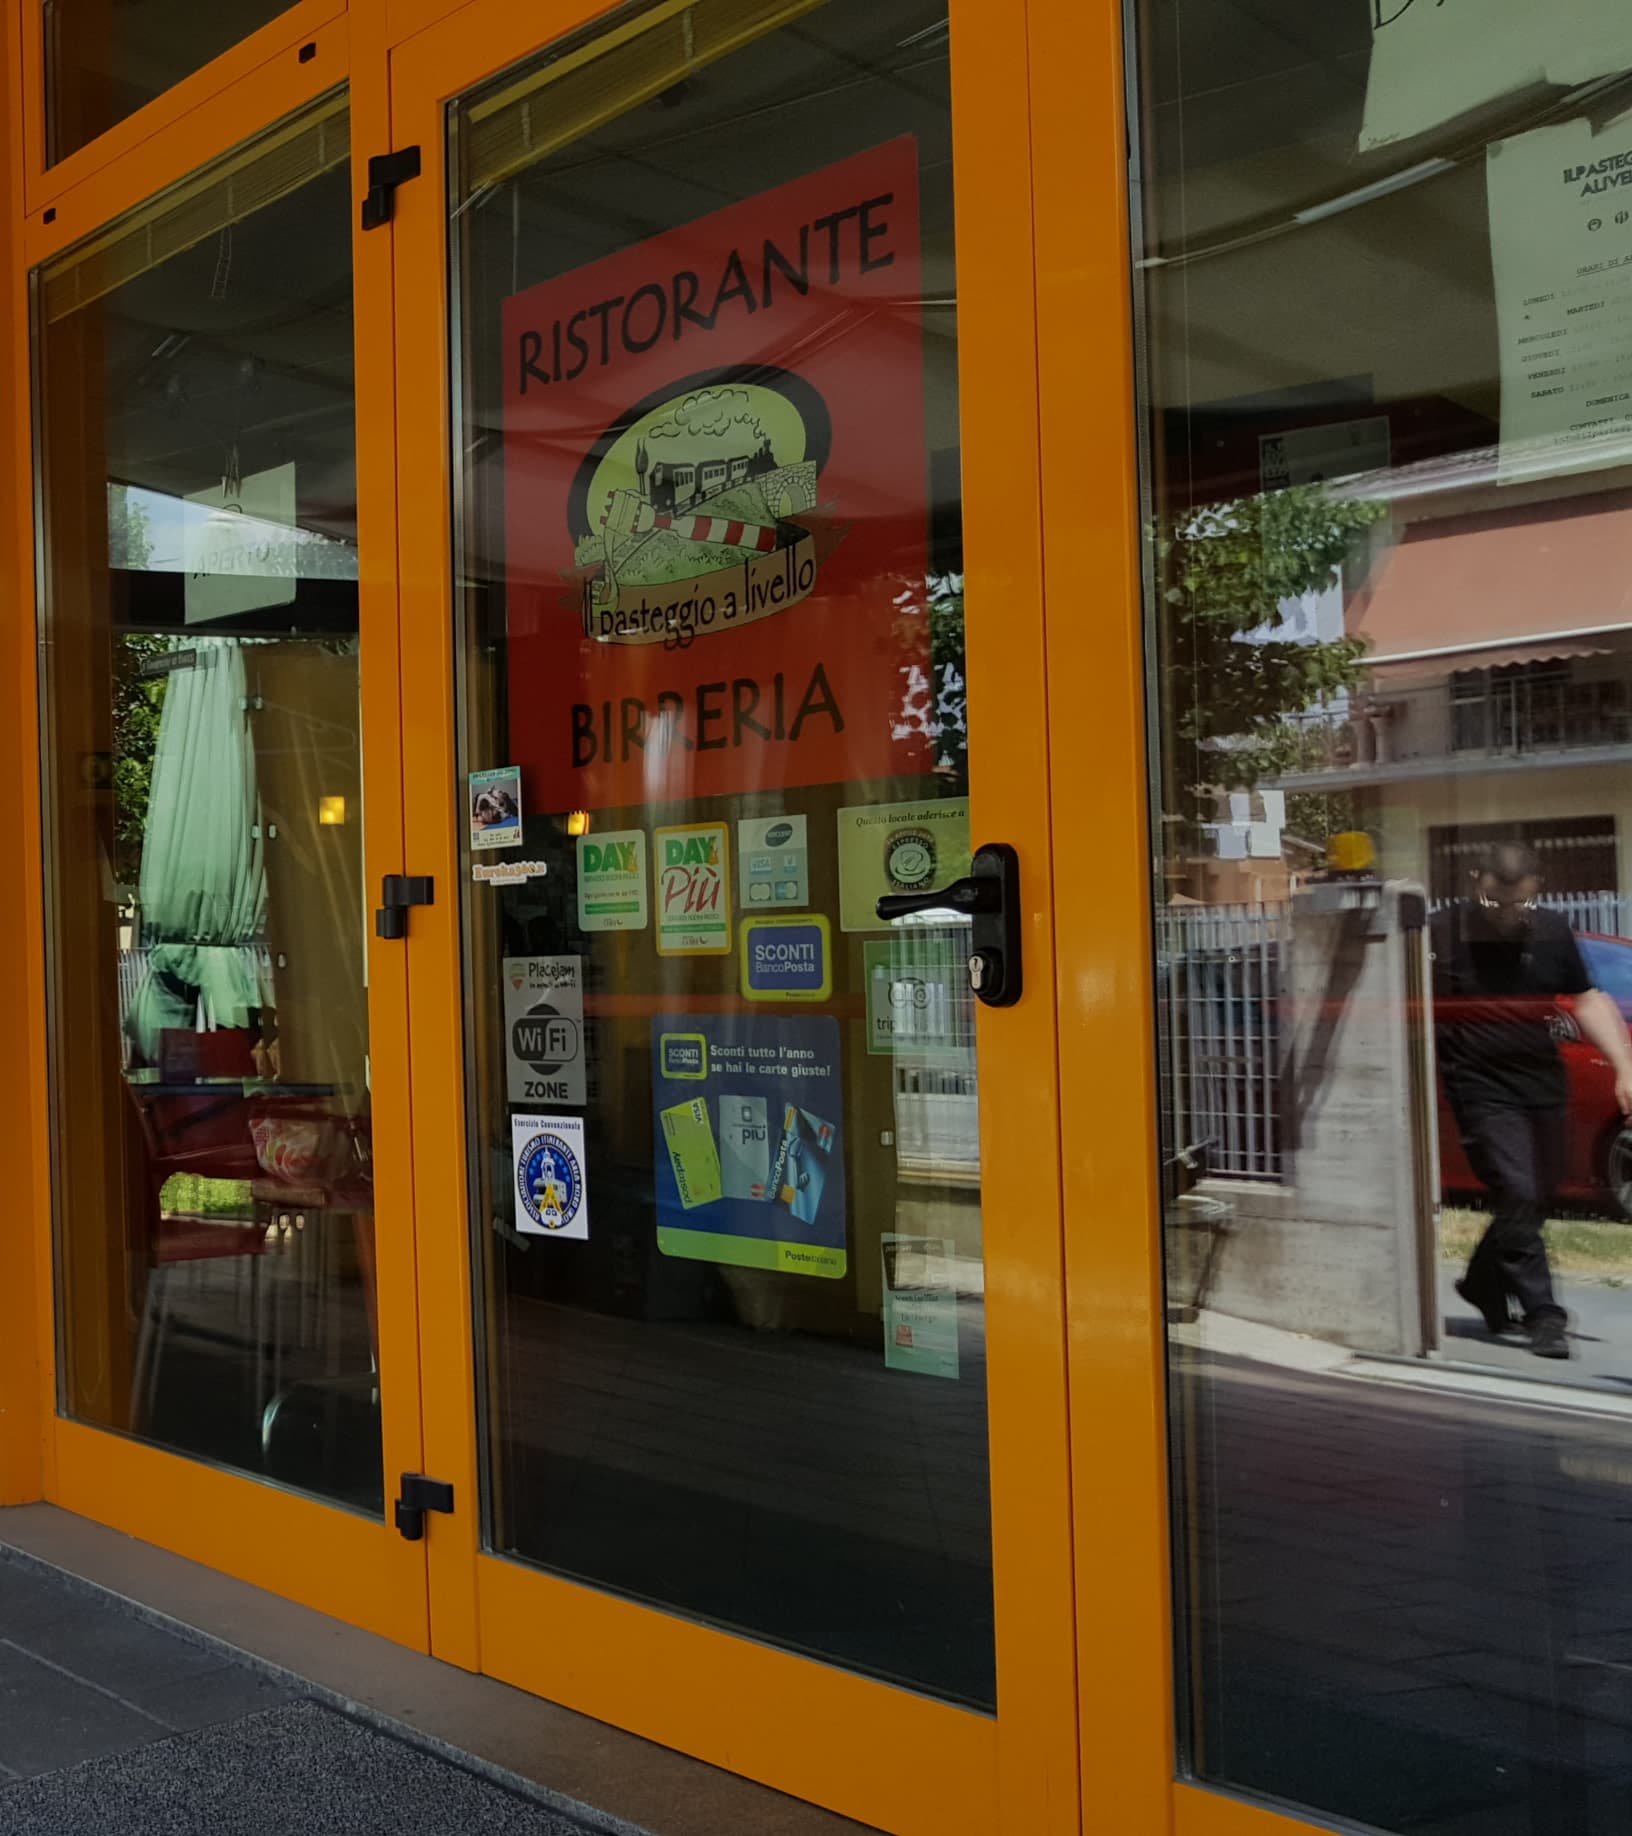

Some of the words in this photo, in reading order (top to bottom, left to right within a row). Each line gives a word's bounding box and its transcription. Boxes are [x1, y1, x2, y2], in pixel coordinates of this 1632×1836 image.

[518, 192, 895, 395] RISTORANTE
[583, 576, 594, 638] Il
[600, 583, 716, 651] pasteggio
[723, 591, 736, 620] a
[745, 542, 814, 615] livello
[571, 662, 845, 769] BIRRERIA
[888, 812, 915, 823] locale
[917, 809, 957, 821] aderisce
[583, 841, 637, 873] DAY
[665, 836, 718, 866] DAY
[661, 866, 721, 913] Più
[892, 877, 929, 889] ITALIANO
[755, 943, 815, 961] SCONTI
[529, 962, 575, 980] Placejam
[755, 961, 816, 974] BancoPosta
[710, 1045, 745, 1056] Sconti
[748, 1047, 776, 1058] tutto
[779, 1047, 815, 1059] l'anno
[711, 1063, 723, 1072] se
[725, 1062, 743, 1073] hai
[745, 1063, 757, 1073] le
[758, 1064, 788, 1075] carte
[791, 1065, 831, 1078] giuste!
[524, 1081, 569, 1099] ZONE
